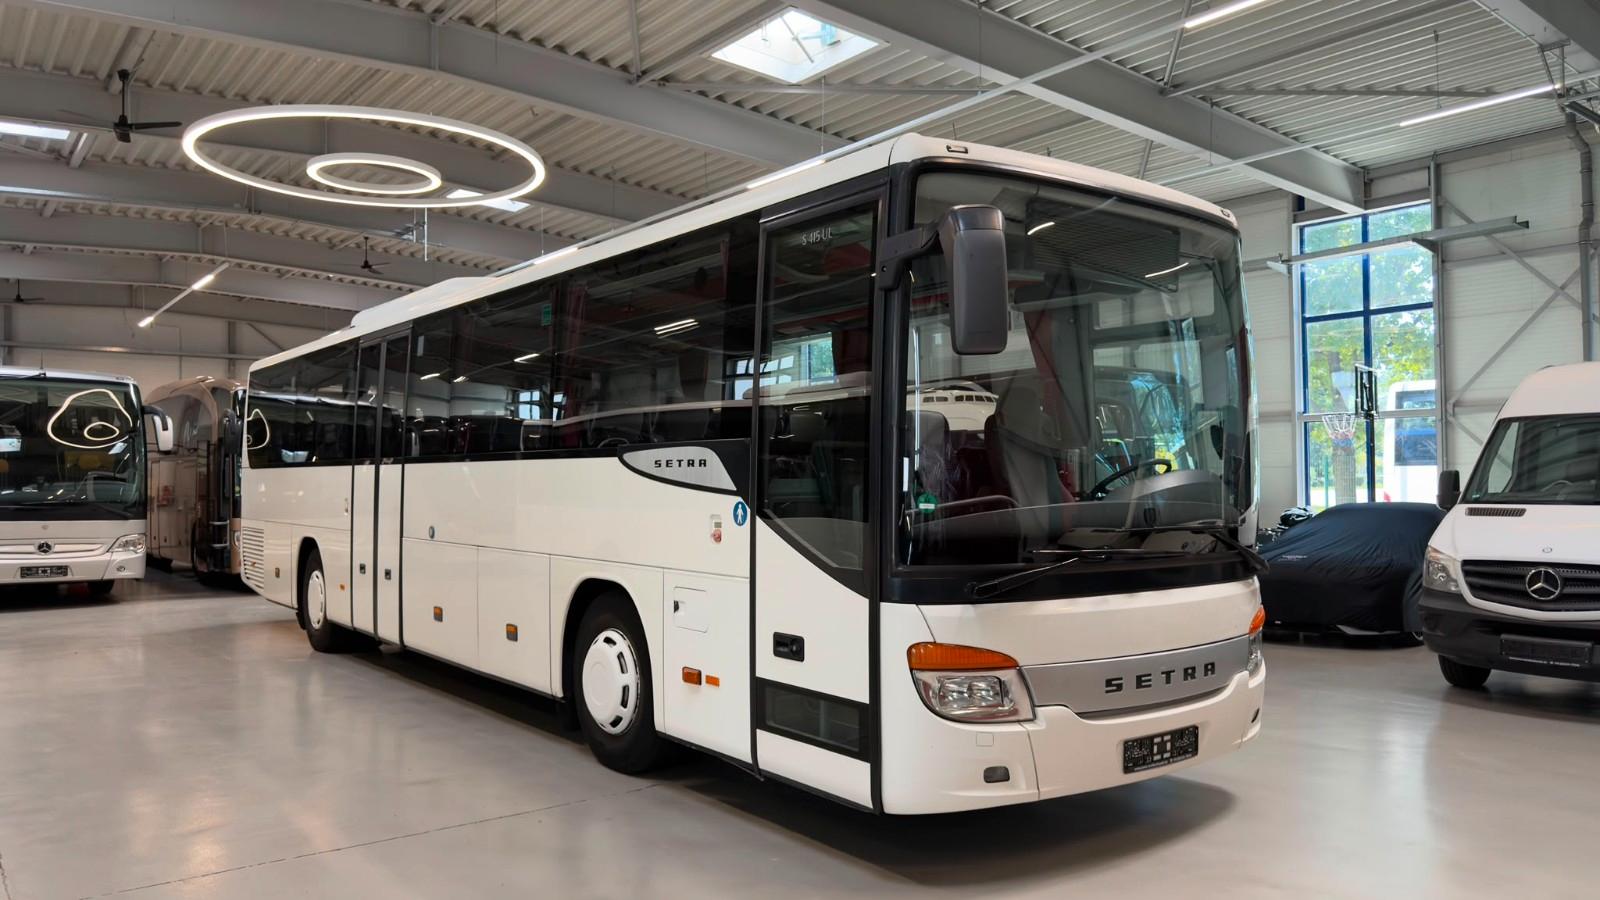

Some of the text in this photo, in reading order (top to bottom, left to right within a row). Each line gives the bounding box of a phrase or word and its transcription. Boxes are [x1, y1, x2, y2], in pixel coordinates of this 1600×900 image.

[801, 233, 807, 246] S
[822, 227, 832, 240] UL
[654, 459, 707, 468] SETRA
[1104, 662, 1216, 694] SETRA
